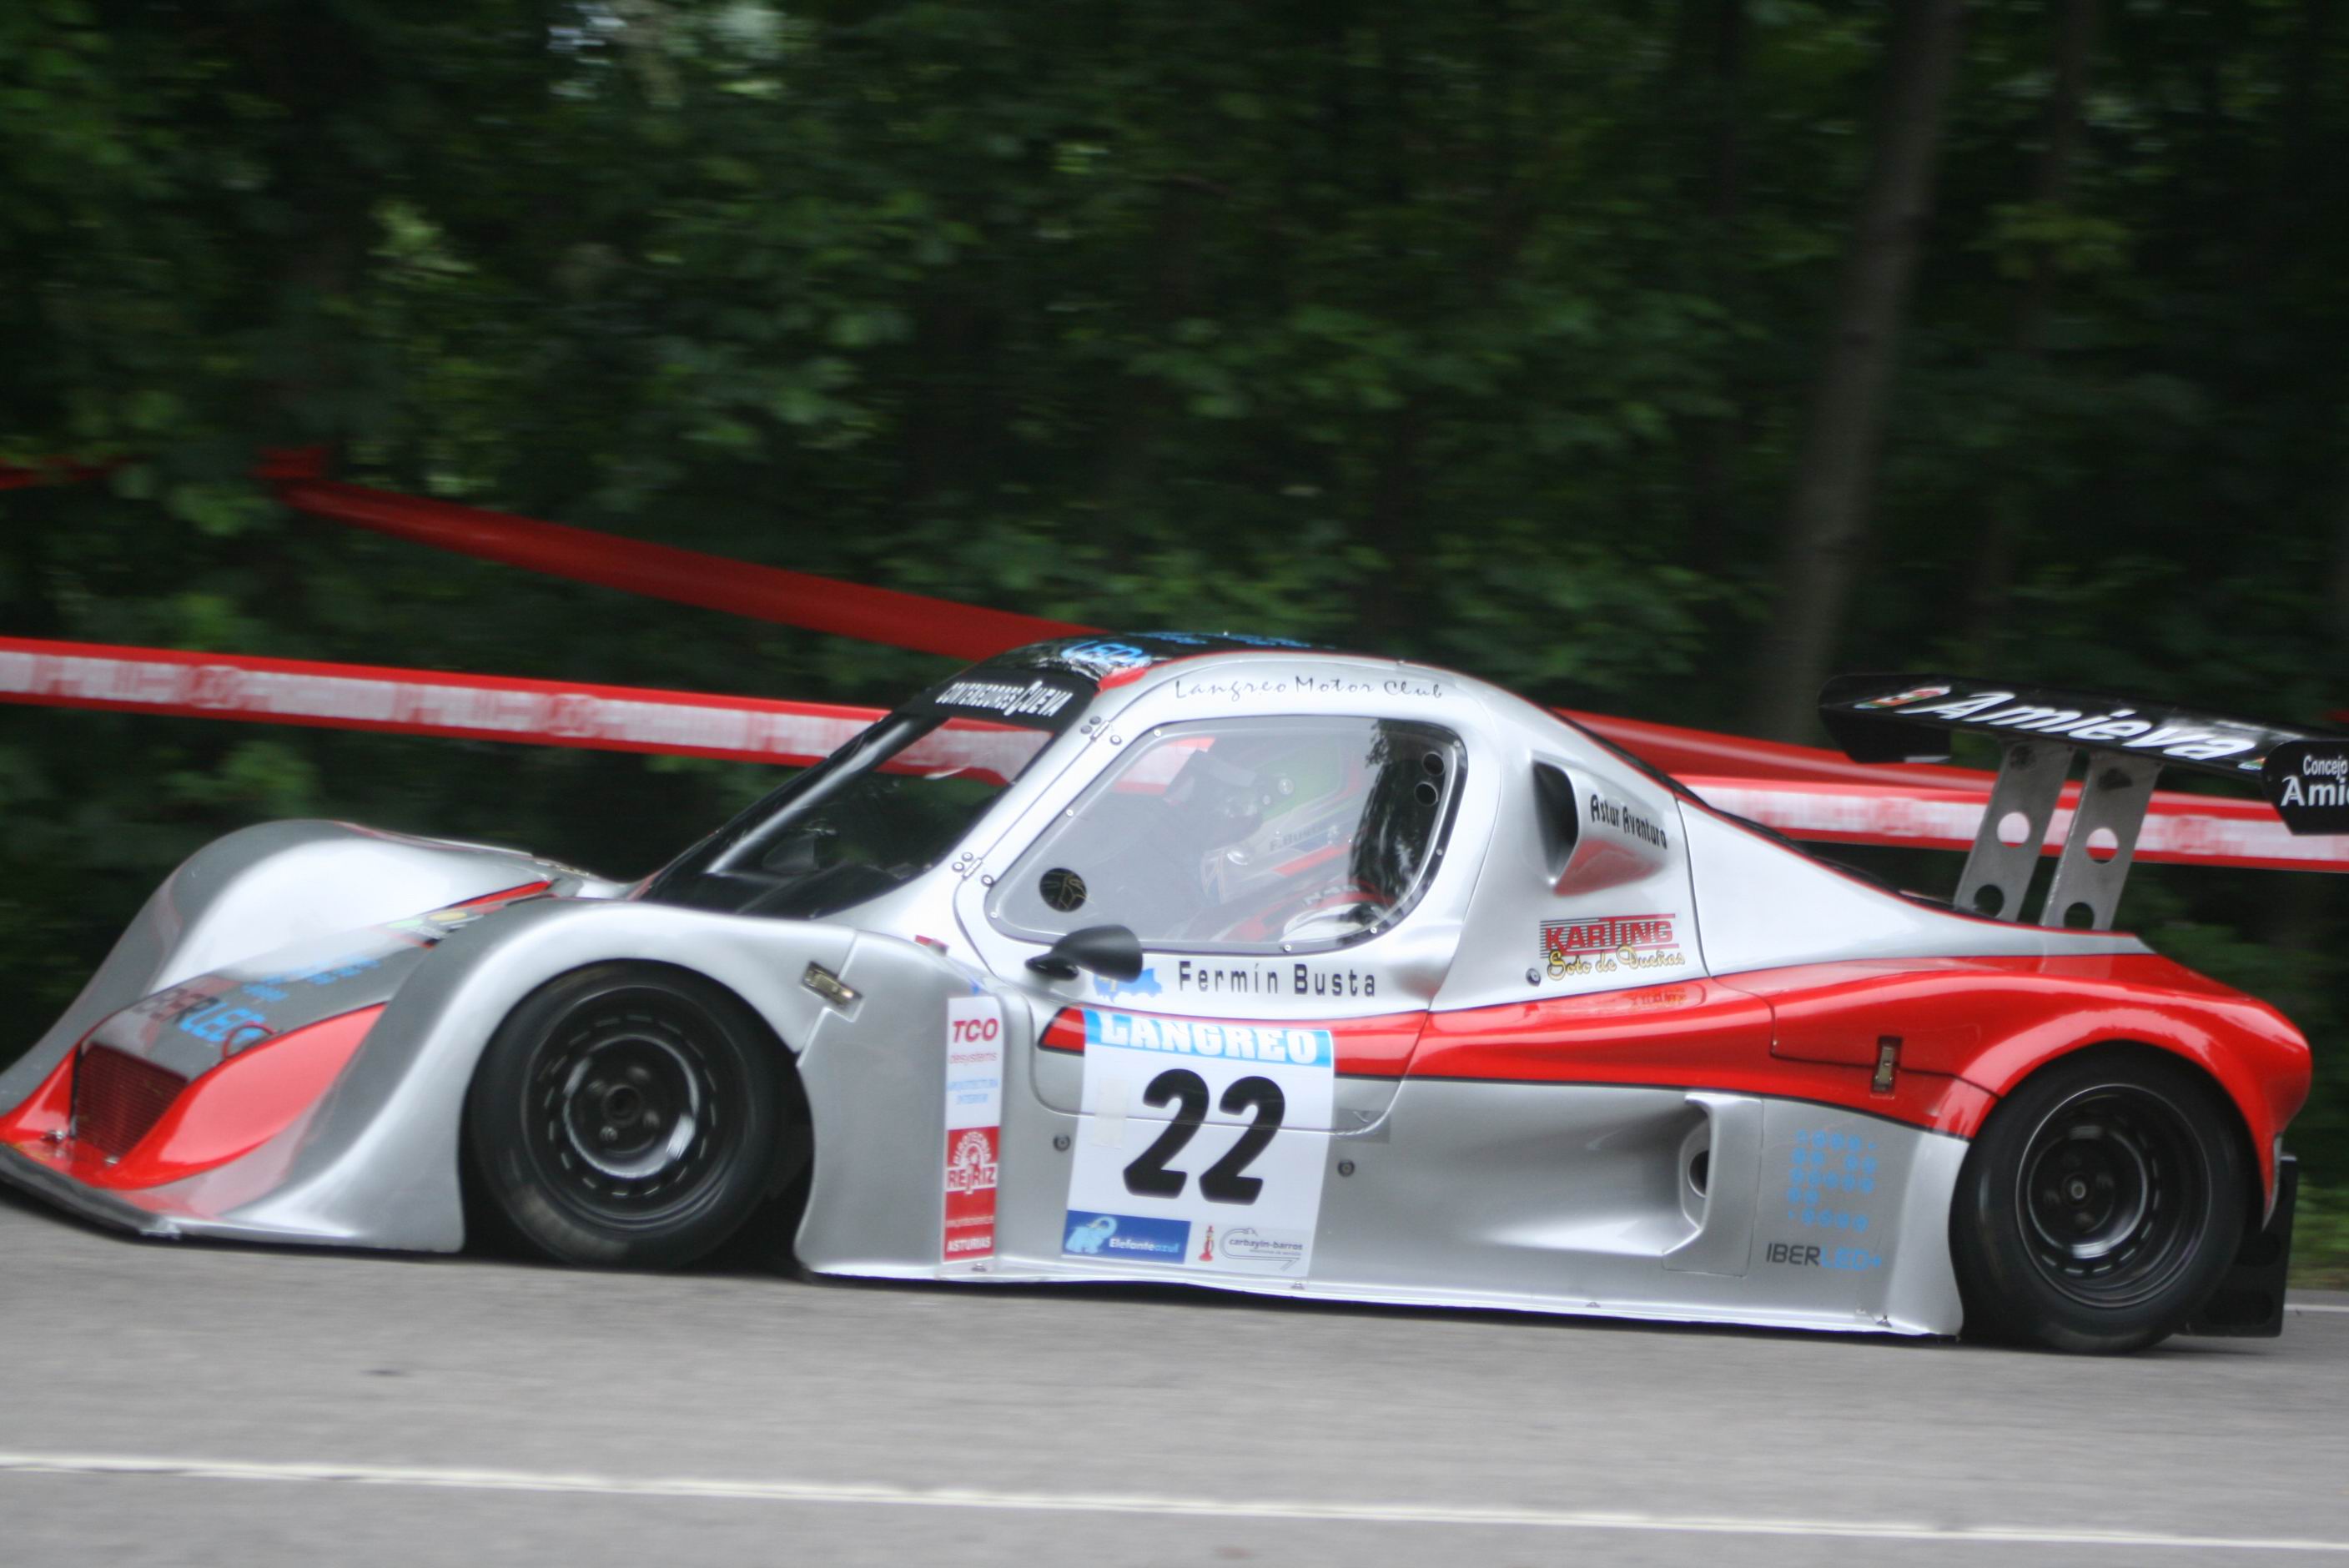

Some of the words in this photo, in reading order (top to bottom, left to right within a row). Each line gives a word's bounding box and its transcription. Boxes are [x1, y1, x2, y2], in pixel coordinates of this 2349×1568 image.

[1175, 680, 1287, 701] Langreo
[1295, 676, 1375, 692] Motor
[1384, 681, 1442, 698] Club
[1894, 691, 2255, 760] Amieva
[2303, 755, 2347, 780] Concejo
[1591, 794, 1620, 827] Astur
[1622, 807, 1667, 850] Aventura
[1546, 915, 1674, 953] KARTING
[1179, 961, 1279, 995] Fermín
[1294, 963, 1376, 998] Busta
[1547, 949, 1592, 981] Soto
[1595, 951, 1617, 972] de
[953, 1018, 998, 1043] TCO
[1099, 1009, 1318, 1064] LANGREO
[1123, 1068, 1285, 1206] 22
